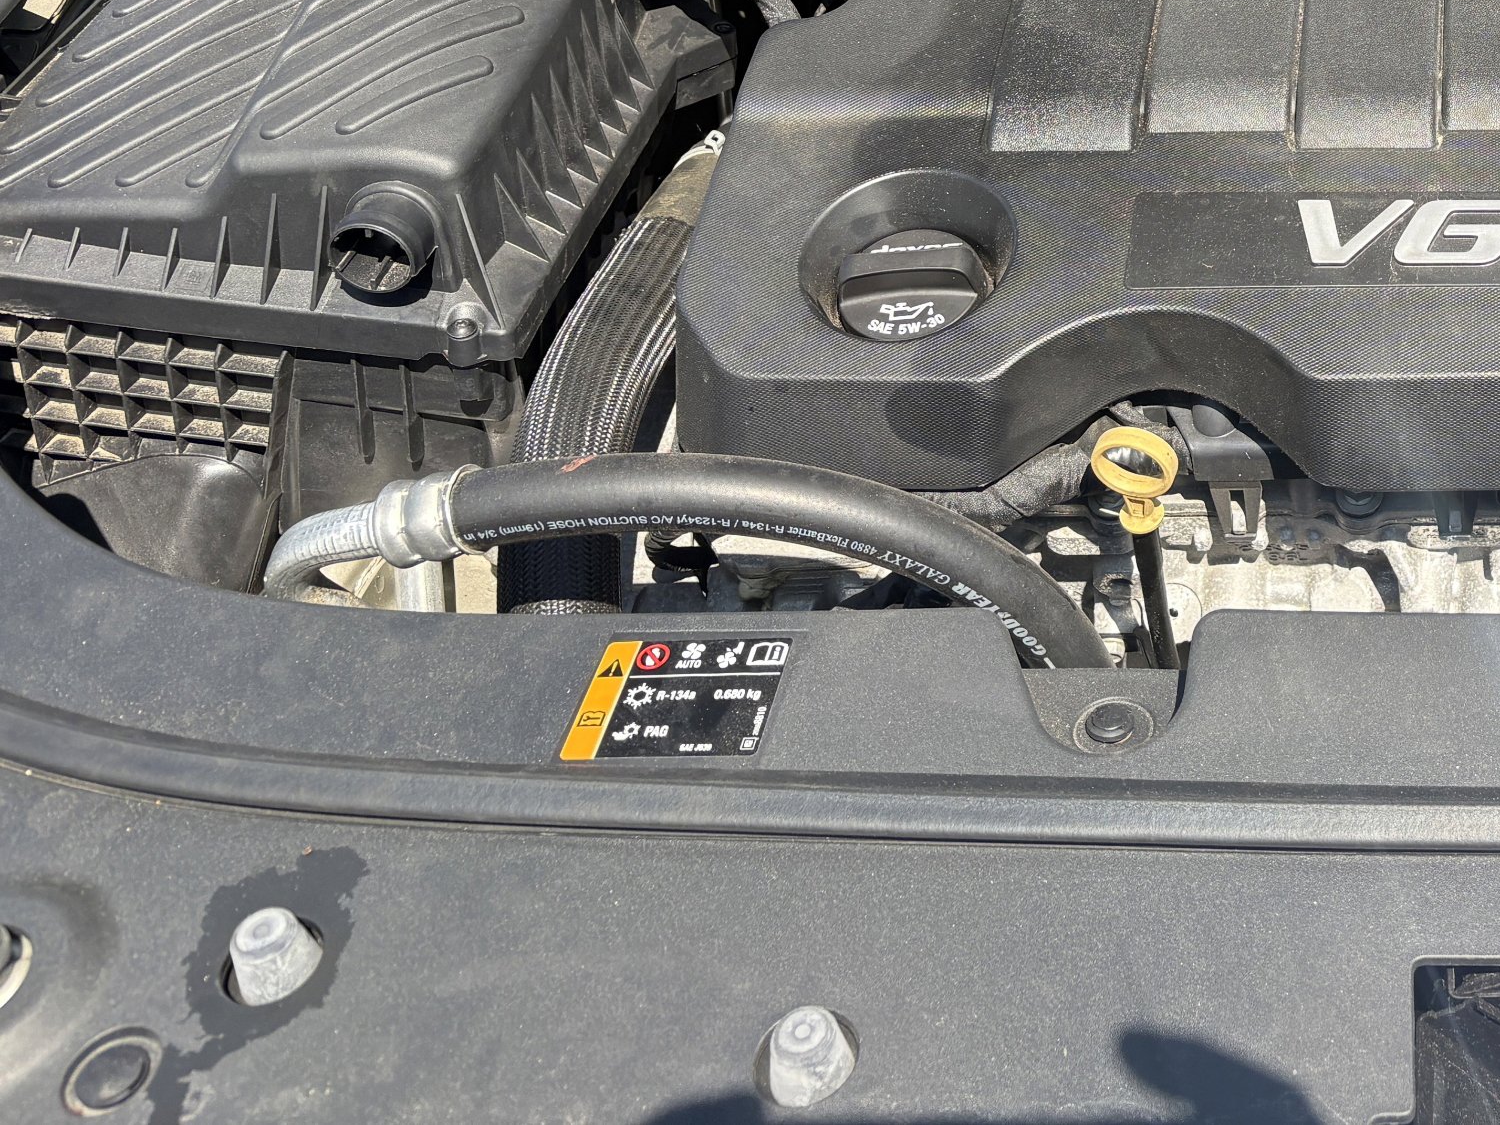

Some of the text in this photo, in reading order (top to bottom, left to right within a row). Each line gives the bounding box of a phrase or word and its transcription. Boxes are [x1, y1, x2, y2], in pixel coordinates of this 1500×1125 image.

[867, 313, 946, 335] SAE 5W-30
[546, 517, 586, 530] HOSE
[588, 515, 648, 527] SUCTION
[650, 515, 673, 525] A/C
[676, 515, 731, 528] R-1234yf
[499, 520, 546, 536] (19mm)
[741, 520, 785, 534] R-134a
[463, 532, 477, 542] in
[476, 529, 498, 541] 3/4
[786, 526, 850, 548] FlexBarrier
[850, 540, 878, 556] 4880
[876, 550, 951, 586] GALAXY
[951, 581, 1047, 656] GOODYEAR
[675, 659, 702, 669] AUTO
[655, 689, 697, 701] R-134a
[746, 688, 762, 701] kg
[643, 725, 670, 737] PAG
